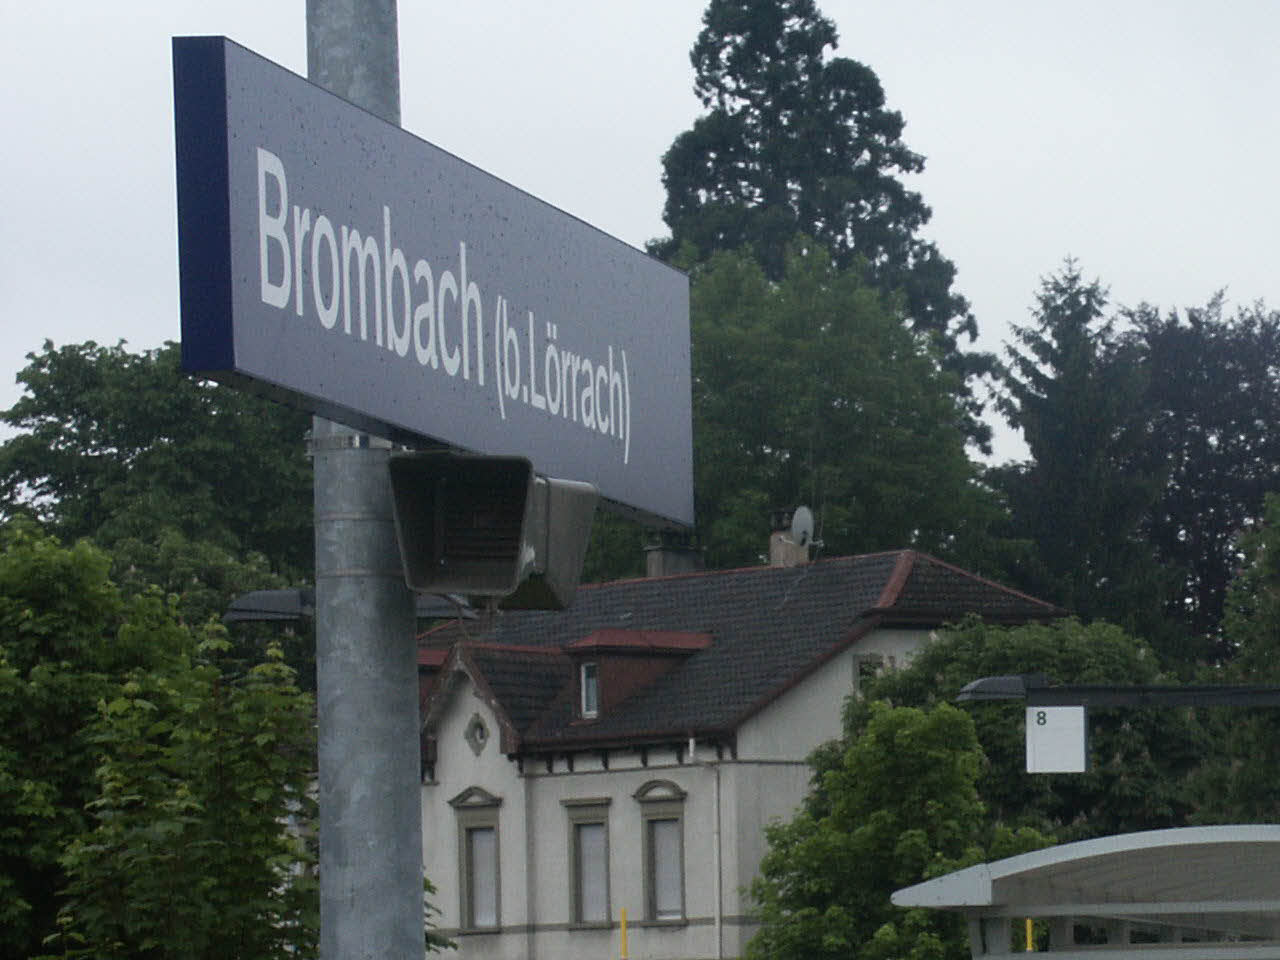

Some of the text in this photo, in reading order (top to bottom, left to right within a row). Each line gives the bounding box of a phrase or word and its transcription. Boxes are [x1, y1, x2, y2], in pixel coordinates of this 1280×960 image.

[256, 147, 631, 465] Brombach (b.Lörrach)
[1036, 710, 1047, 726] 8
